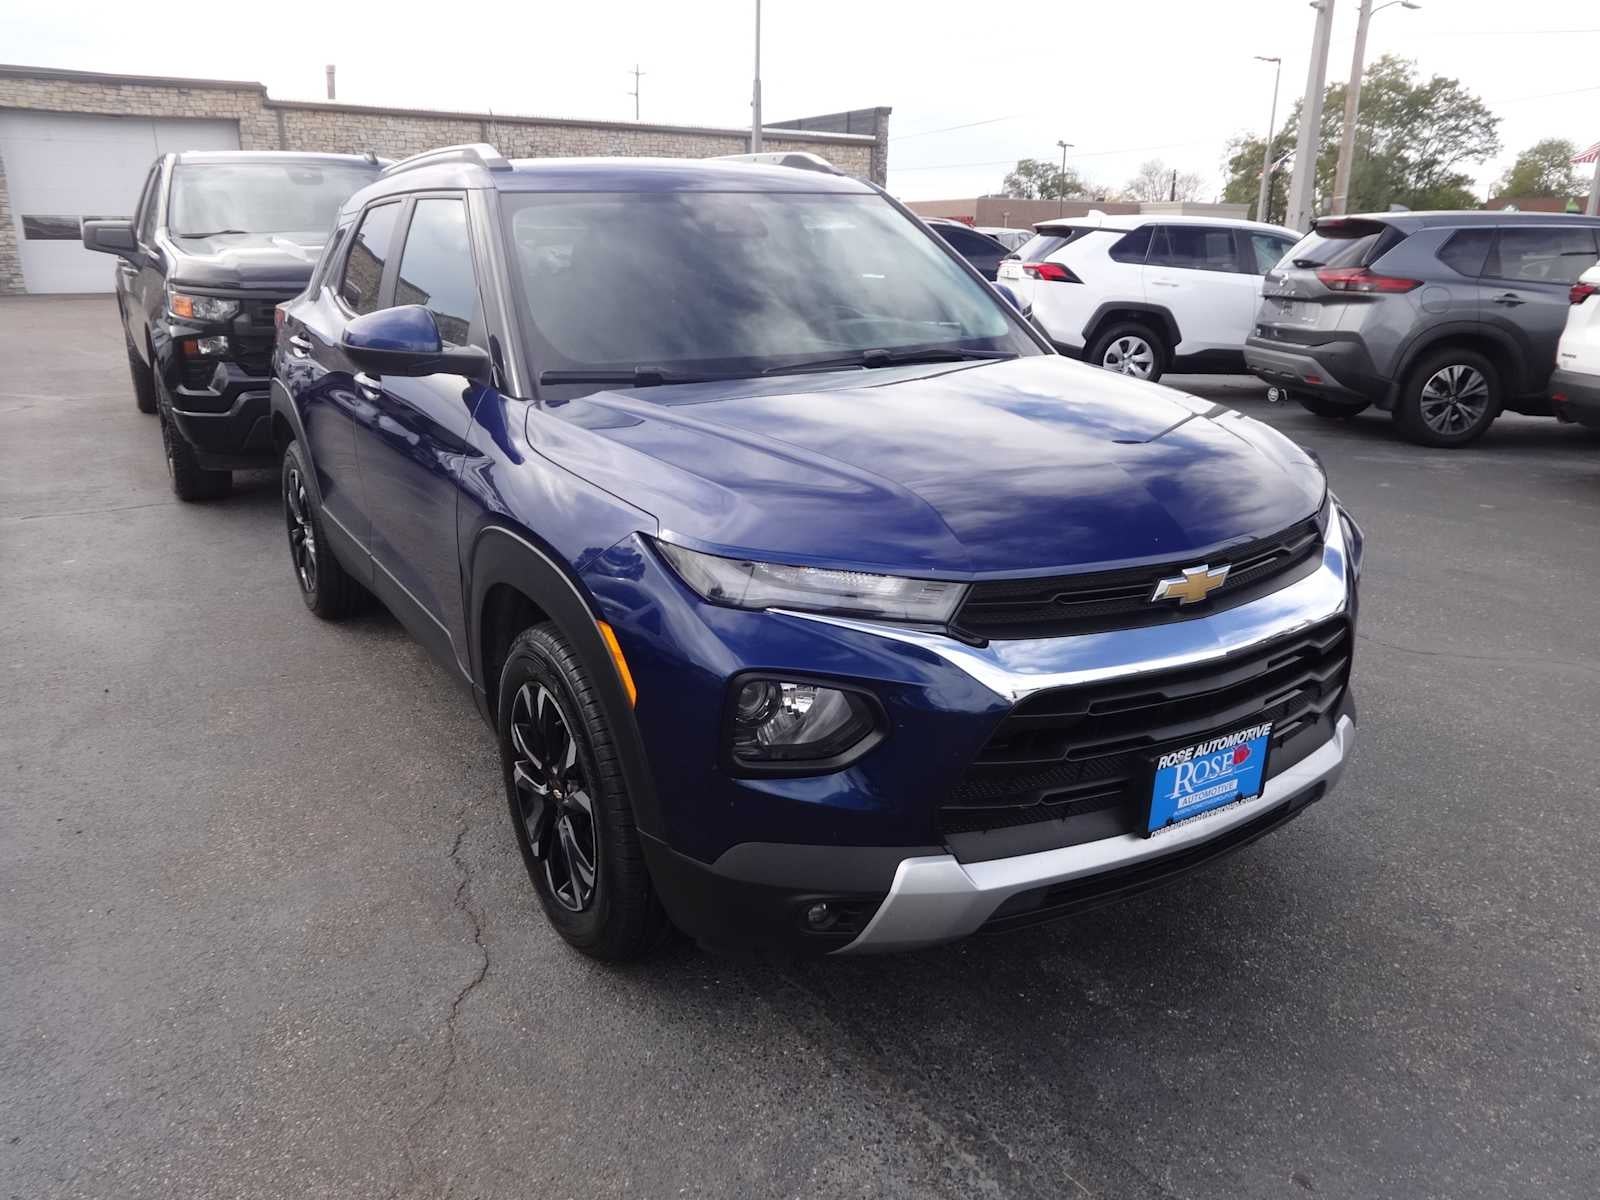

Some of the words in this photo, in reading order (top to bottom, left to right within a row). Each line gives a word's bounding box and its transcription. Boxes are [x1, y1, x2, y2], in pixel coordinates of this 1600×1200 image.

[1157, 747, 1194, 769] ROSE
[1193, 722, 1273, 759] AUTOMOTIVE
[1181, 782, 1235, 806] AUTOMOTIVE
